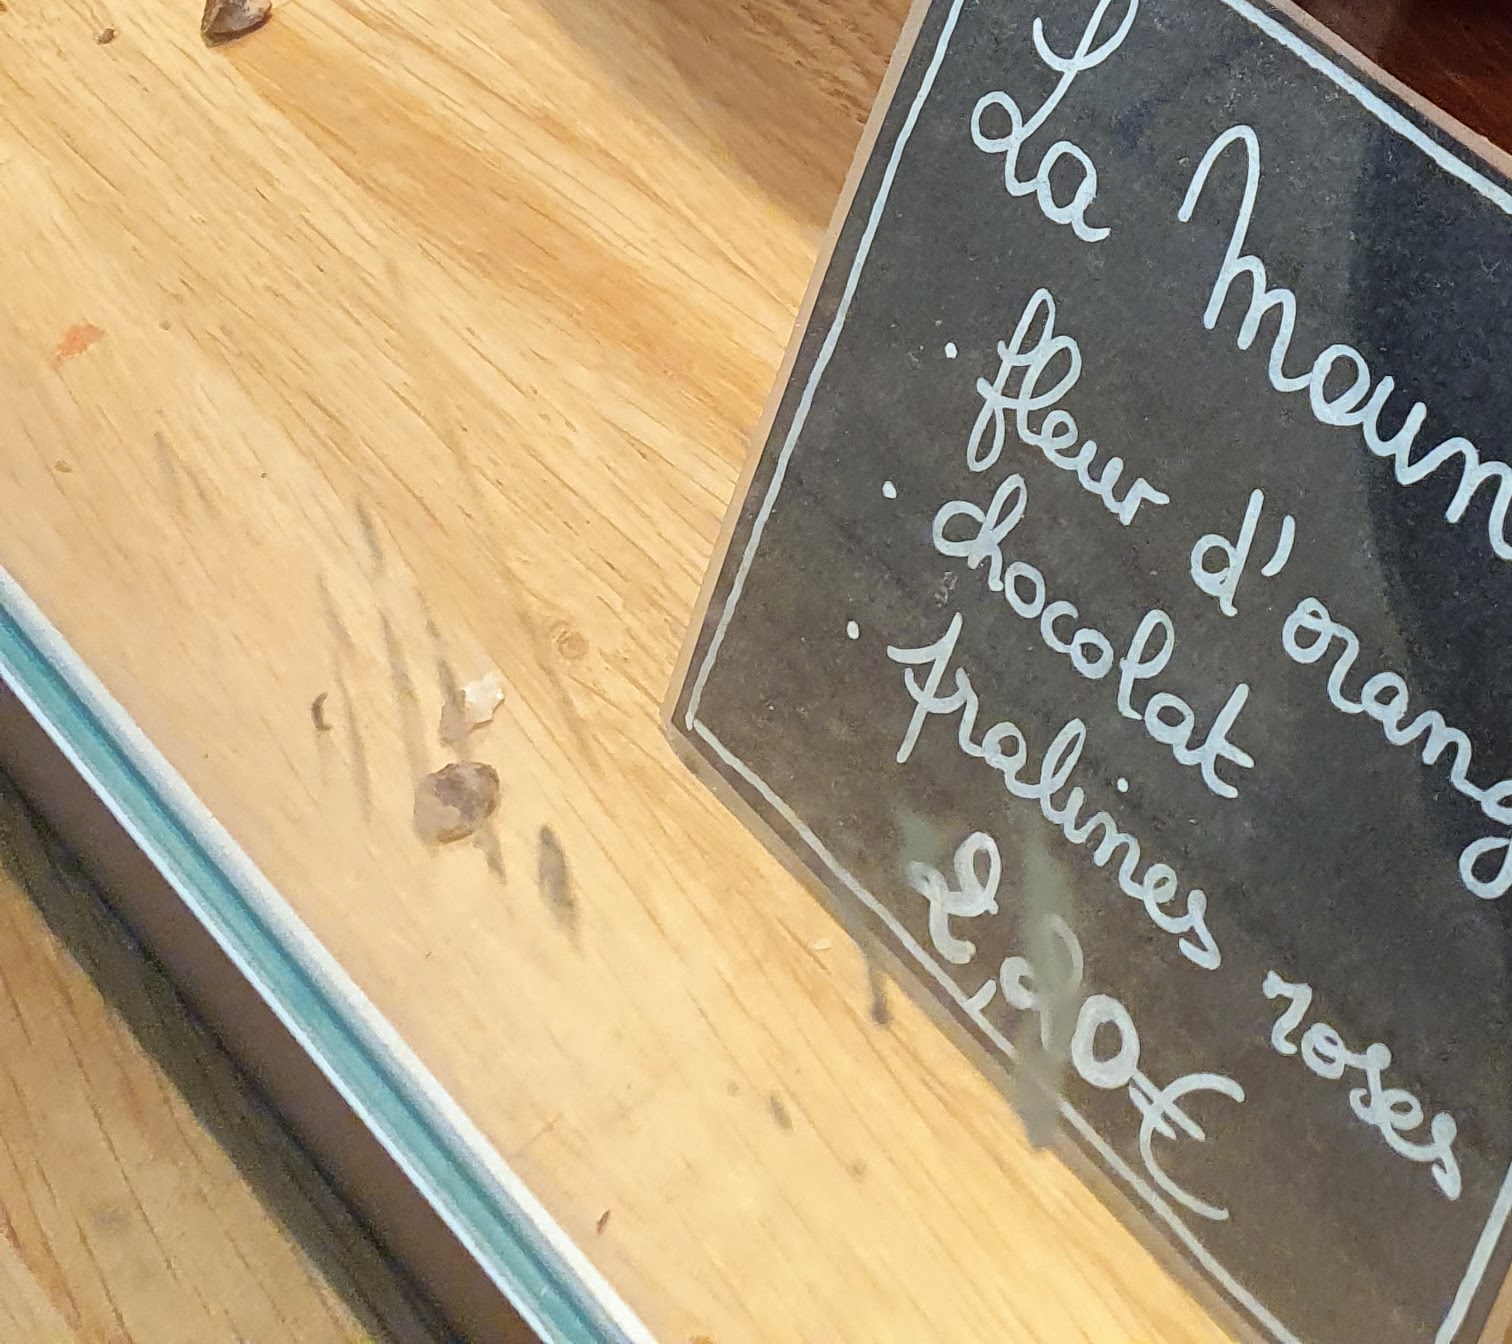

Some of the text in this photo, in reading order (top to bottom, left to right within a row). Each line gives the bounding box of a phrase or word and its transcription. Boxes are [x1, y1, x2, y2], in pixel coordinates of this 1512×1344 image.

[967, 289, 1169, 525] fleur
[931, 474, 1256, 799] chocolat
[887, 613, 1463, 1199] pralines roses
